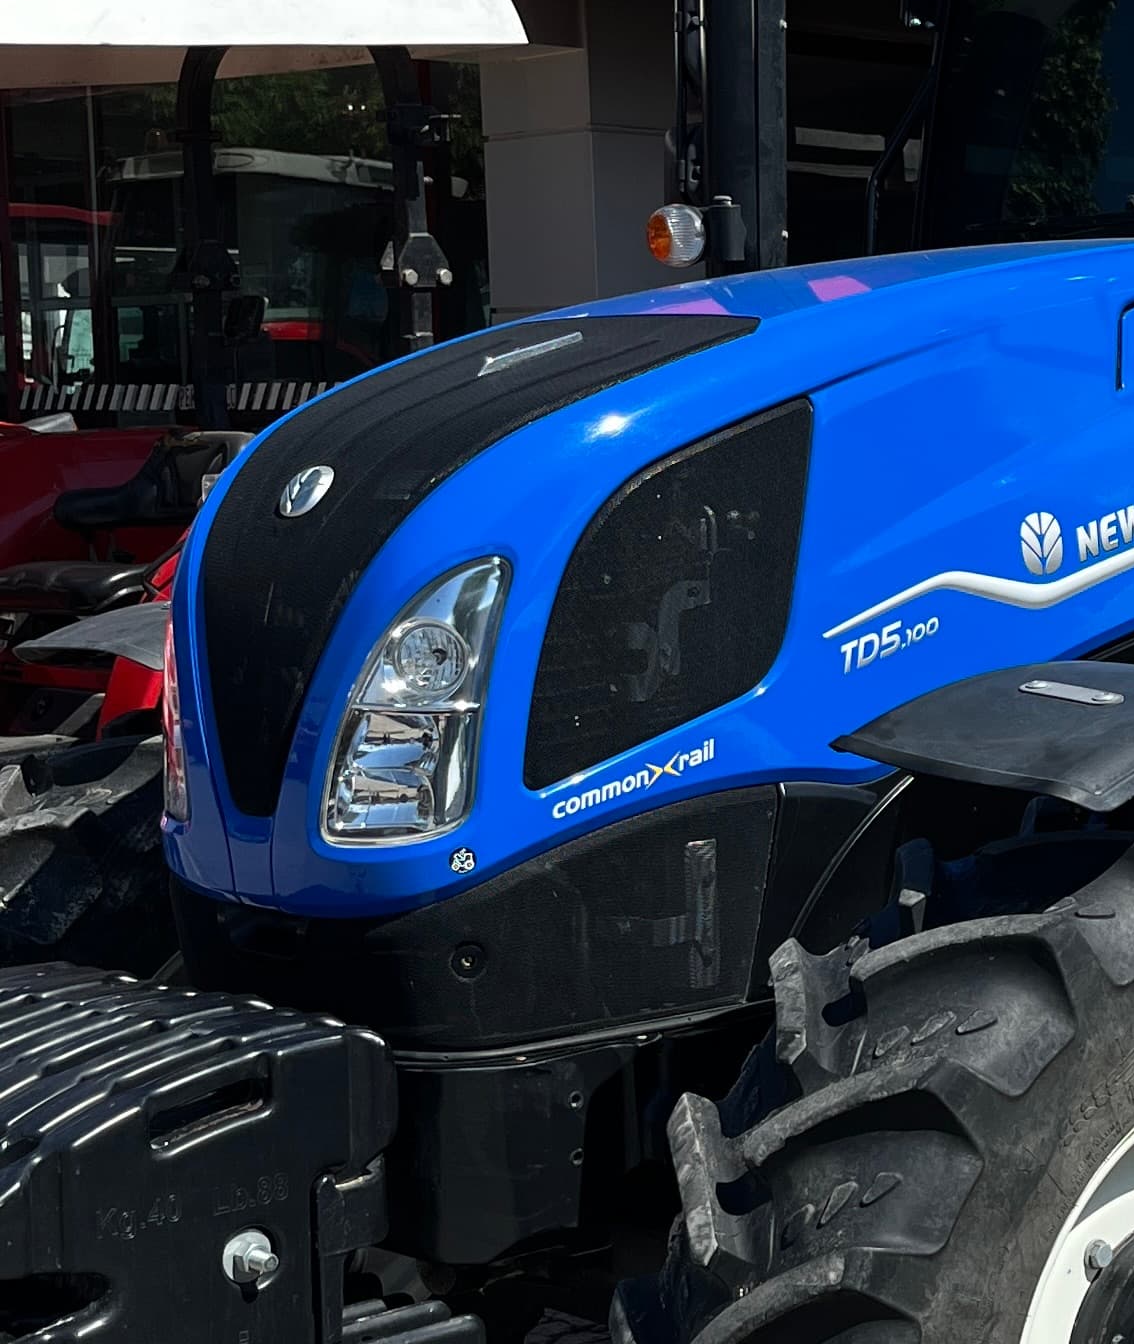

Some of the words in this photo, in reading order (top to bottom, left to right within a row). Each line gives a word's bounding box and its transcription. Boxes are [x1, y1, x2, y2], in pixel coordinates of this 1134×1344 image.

[840, 616, 940, 676] TD5.100
[552, 768, 650, 820] common
[678, 738, 715, 772] rail
